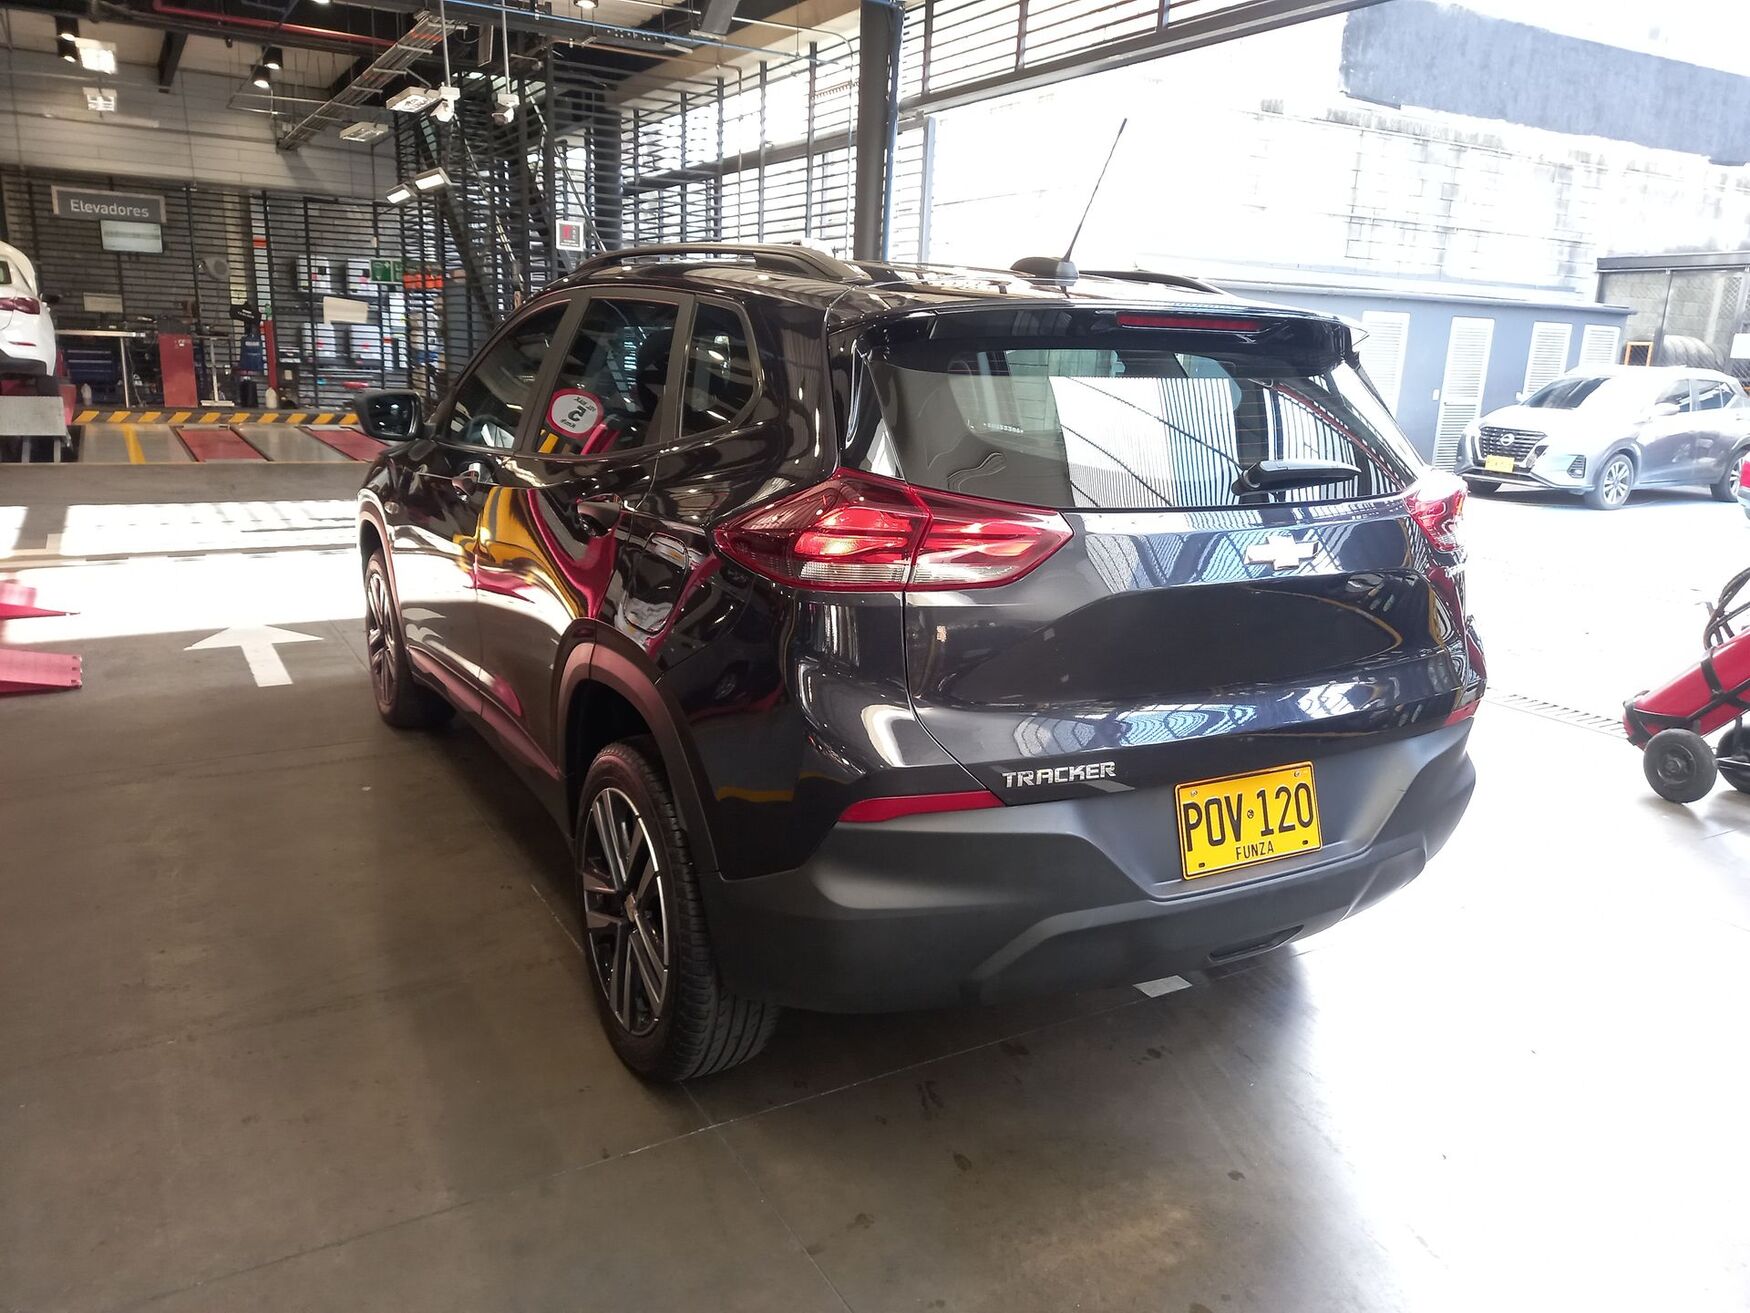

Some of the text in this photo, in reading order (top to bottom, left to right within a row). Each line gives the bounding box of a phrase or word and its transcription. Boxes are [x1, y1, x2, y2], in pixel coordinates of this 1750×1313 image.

[70, 199, 149, 218] Elevadores
[1002, 761, 1116, 788] TRACKER
[1235, 840, 1274, 861] FUNZA
